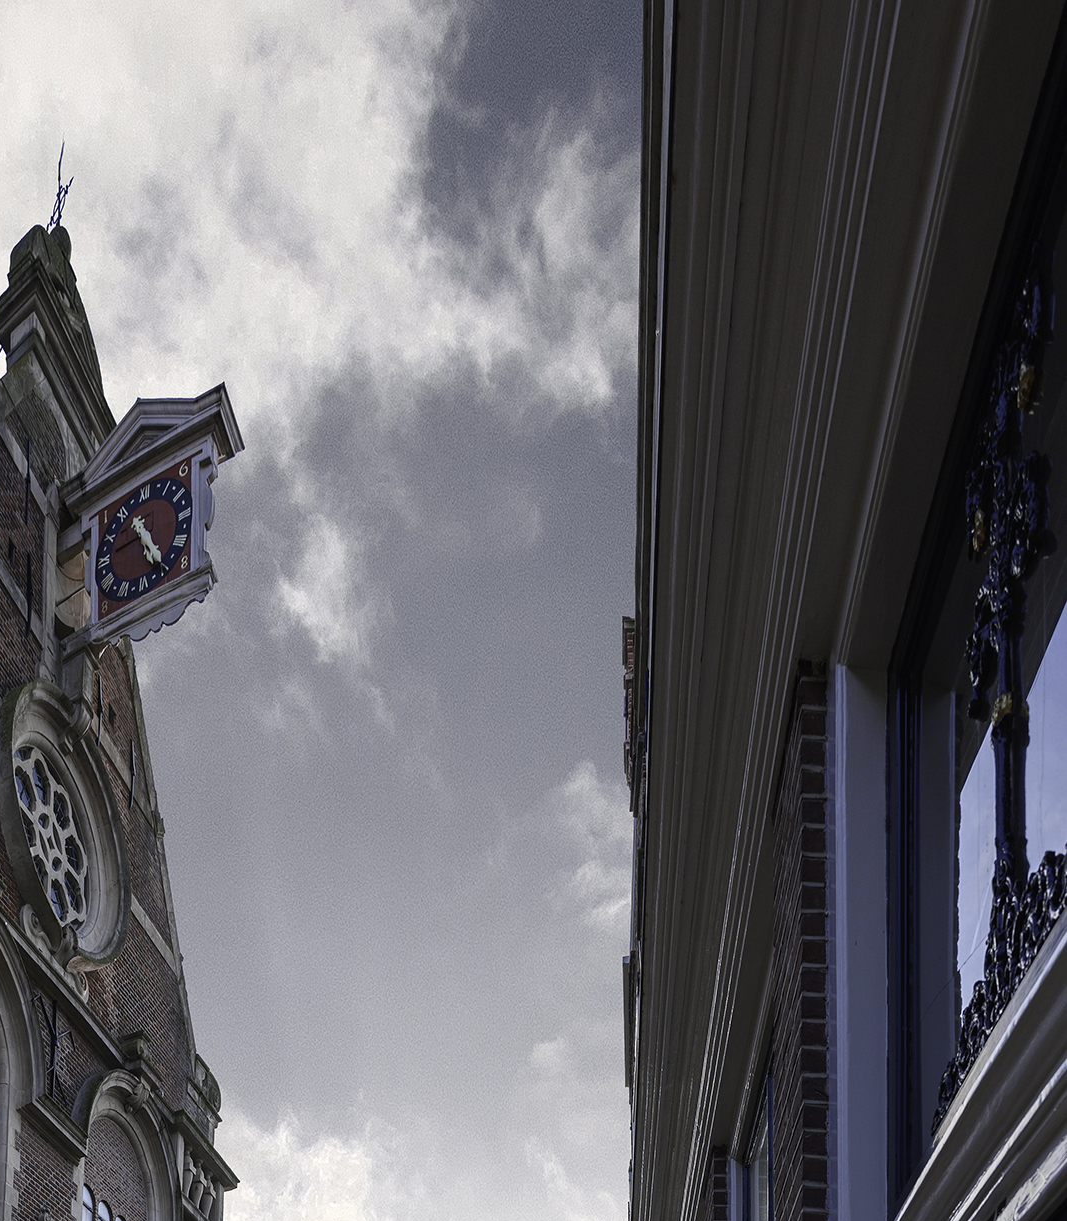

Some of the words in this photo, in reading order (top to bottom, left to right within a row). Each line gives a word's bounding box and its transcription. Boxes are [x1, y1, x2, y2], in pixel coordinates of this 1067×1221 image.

[178, 461, 189, 477] 6
[139, 484, 150, 502] XII
[173, 487, 186, 502] II
[116, 506, 128, 522] XI
[104, 533, 116, 542] X
[98, 554, 110, 569] IX
[101, 600, 108, 614] 8
[180, 556, 188, 570] 8
